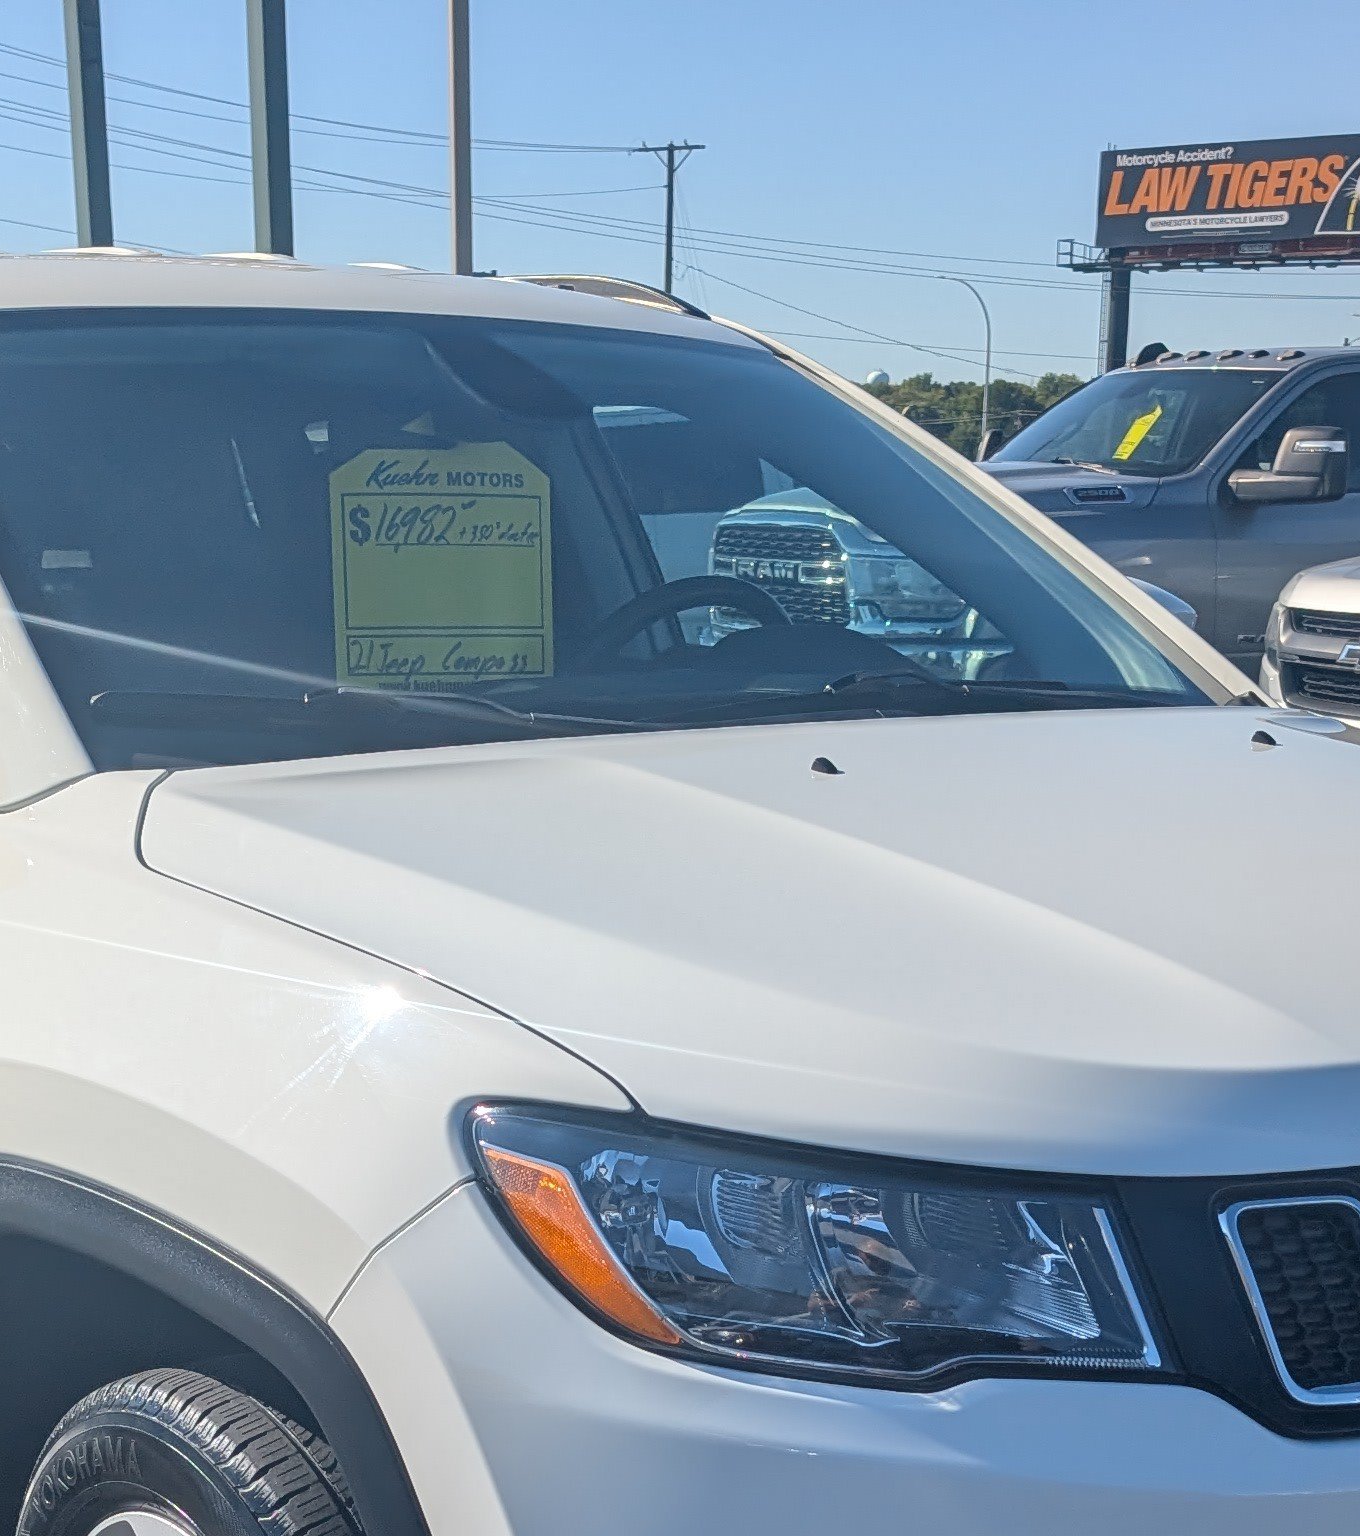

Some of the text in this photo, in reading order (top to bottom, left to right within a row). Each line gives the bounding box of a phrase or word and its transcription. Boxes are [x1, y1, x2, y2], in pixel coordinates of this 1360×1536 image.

[1116, 146, 1234, 167] Motorcycle Accident?
[1104, 154, 1345, 216] LAW TIGERS
[1199, 215, 1248, 226] MOTORCYCLE
[1249, 213, 1284, 223] LAWYERS
[365, 459, 524, 488] Kuehn MOTORS
[377, 642, 426, 682] Jeep
[442, 641, 528, 679] Compass
[31, 1435, 142, 1521] YOKOHAMA
